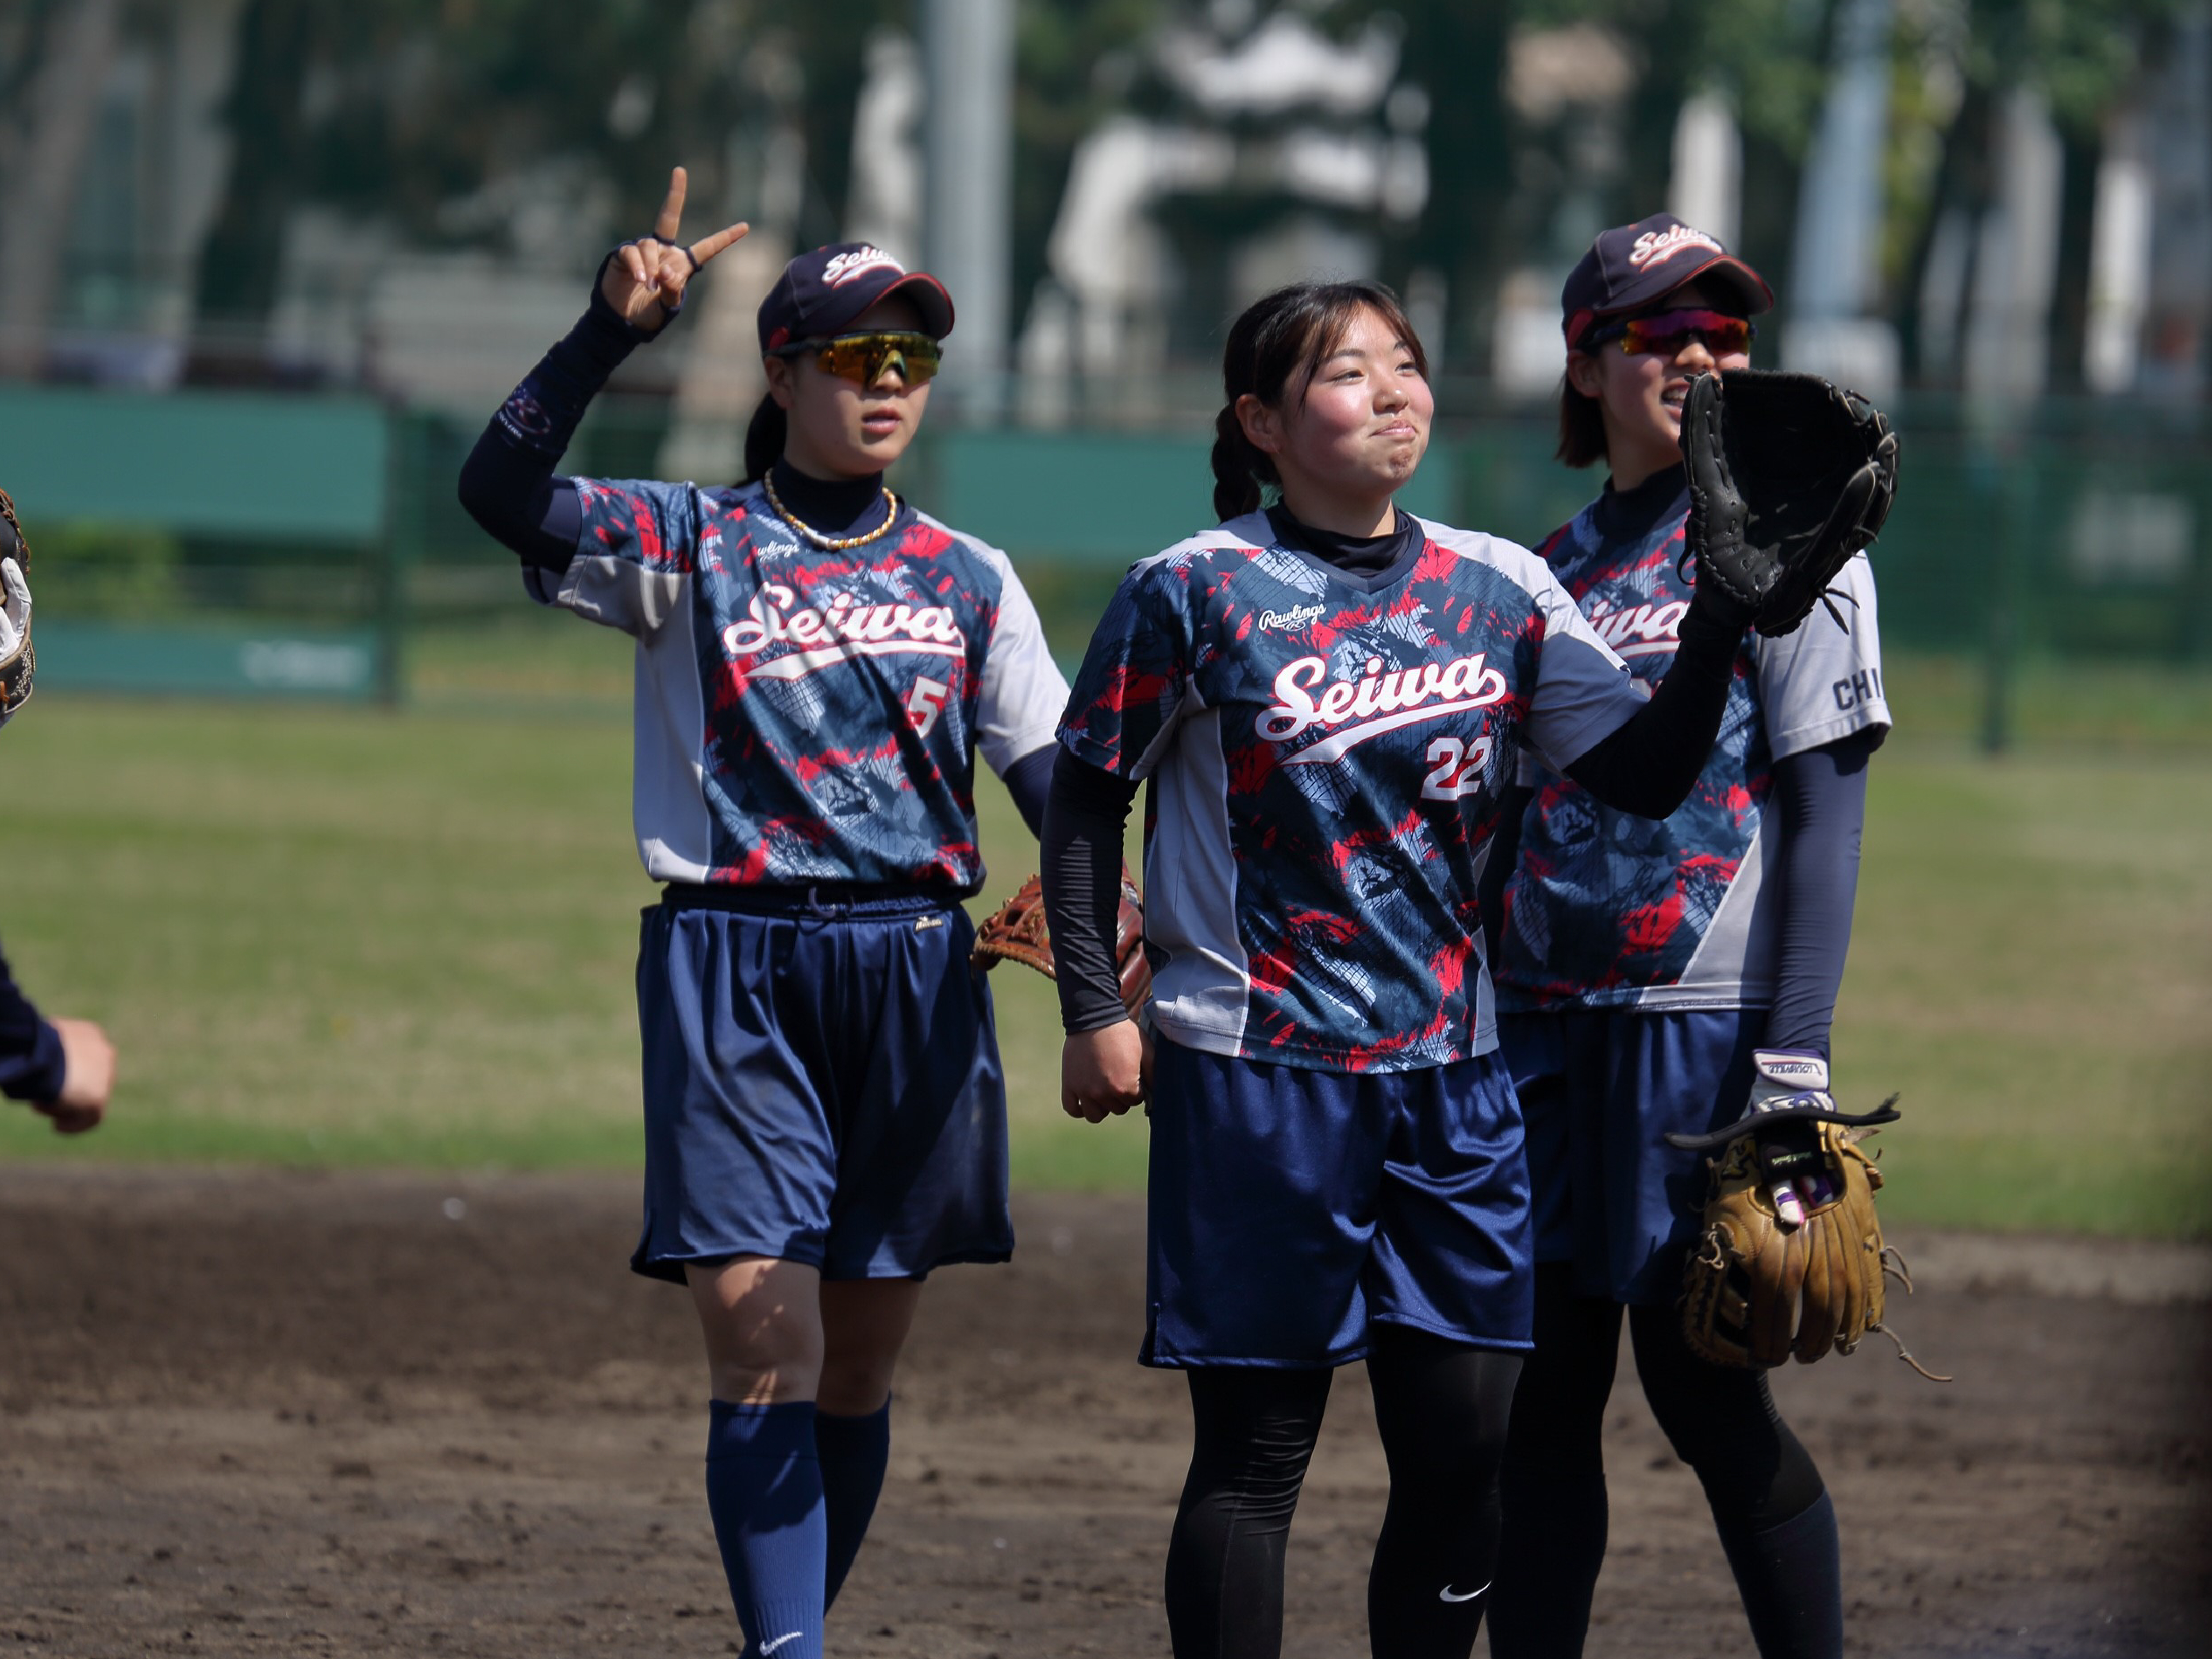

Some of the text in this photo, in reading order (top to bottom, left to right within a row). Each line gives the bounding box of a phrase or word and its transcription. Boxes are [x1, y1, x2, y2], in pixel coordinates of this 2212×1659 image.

[822, 246, 895, 283] Seiw
[758, 540, 800, 558] wlings
[724, 581, 965, 655] Seiwa
[1259, 603, 1327, 631] Rawlings
[1587, 600, 1690, 649] iwa
[908, 676, 947, 739] 5
[1255, 653, 1506, 741] Seiwa
[1420, 736, 1493, 802] 22
